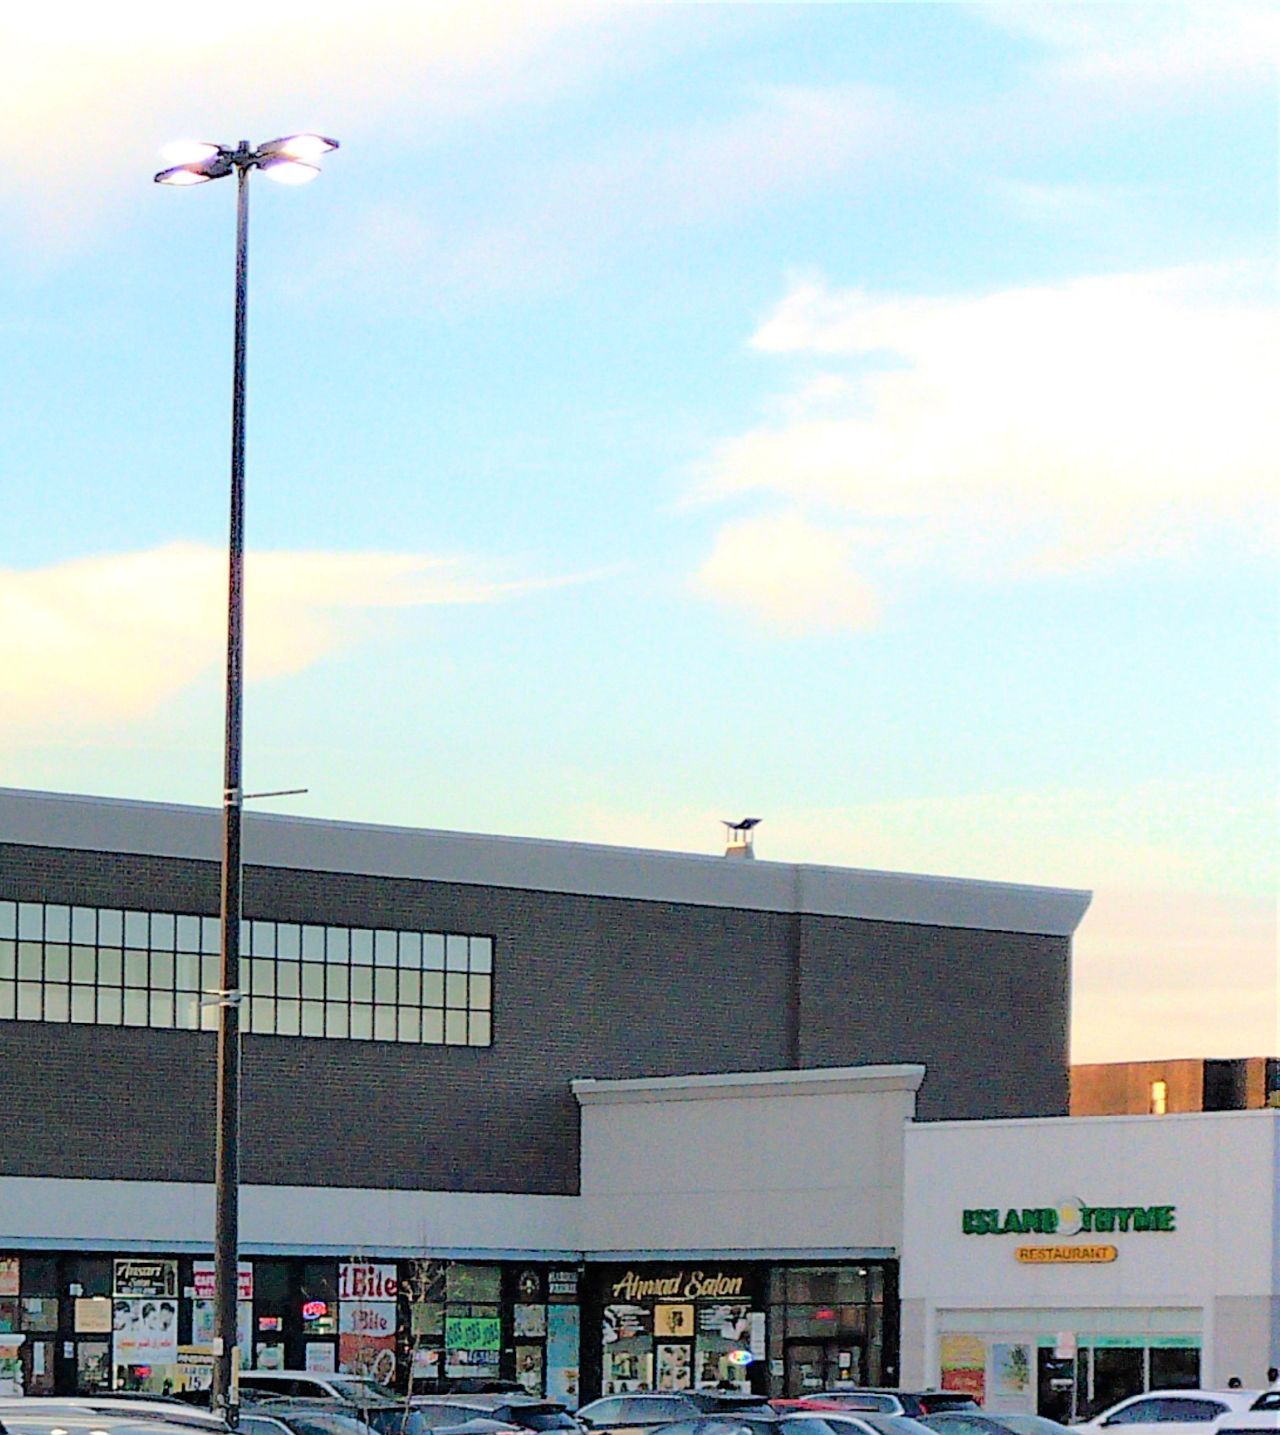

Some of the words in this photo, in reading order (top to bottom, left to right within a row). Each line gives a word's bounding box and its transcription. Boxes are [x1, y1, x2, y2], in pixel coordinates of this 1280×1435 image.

[962, 1208, 1059, 1235] ISLAND
[1078, 1206, 1176, 1233] THYME
[1019, 1247, 1108, 1261] RESTAURANT
[612, 1270, 683, 1300] Ahmad
[683, 1270, 744, 1299] Salon
